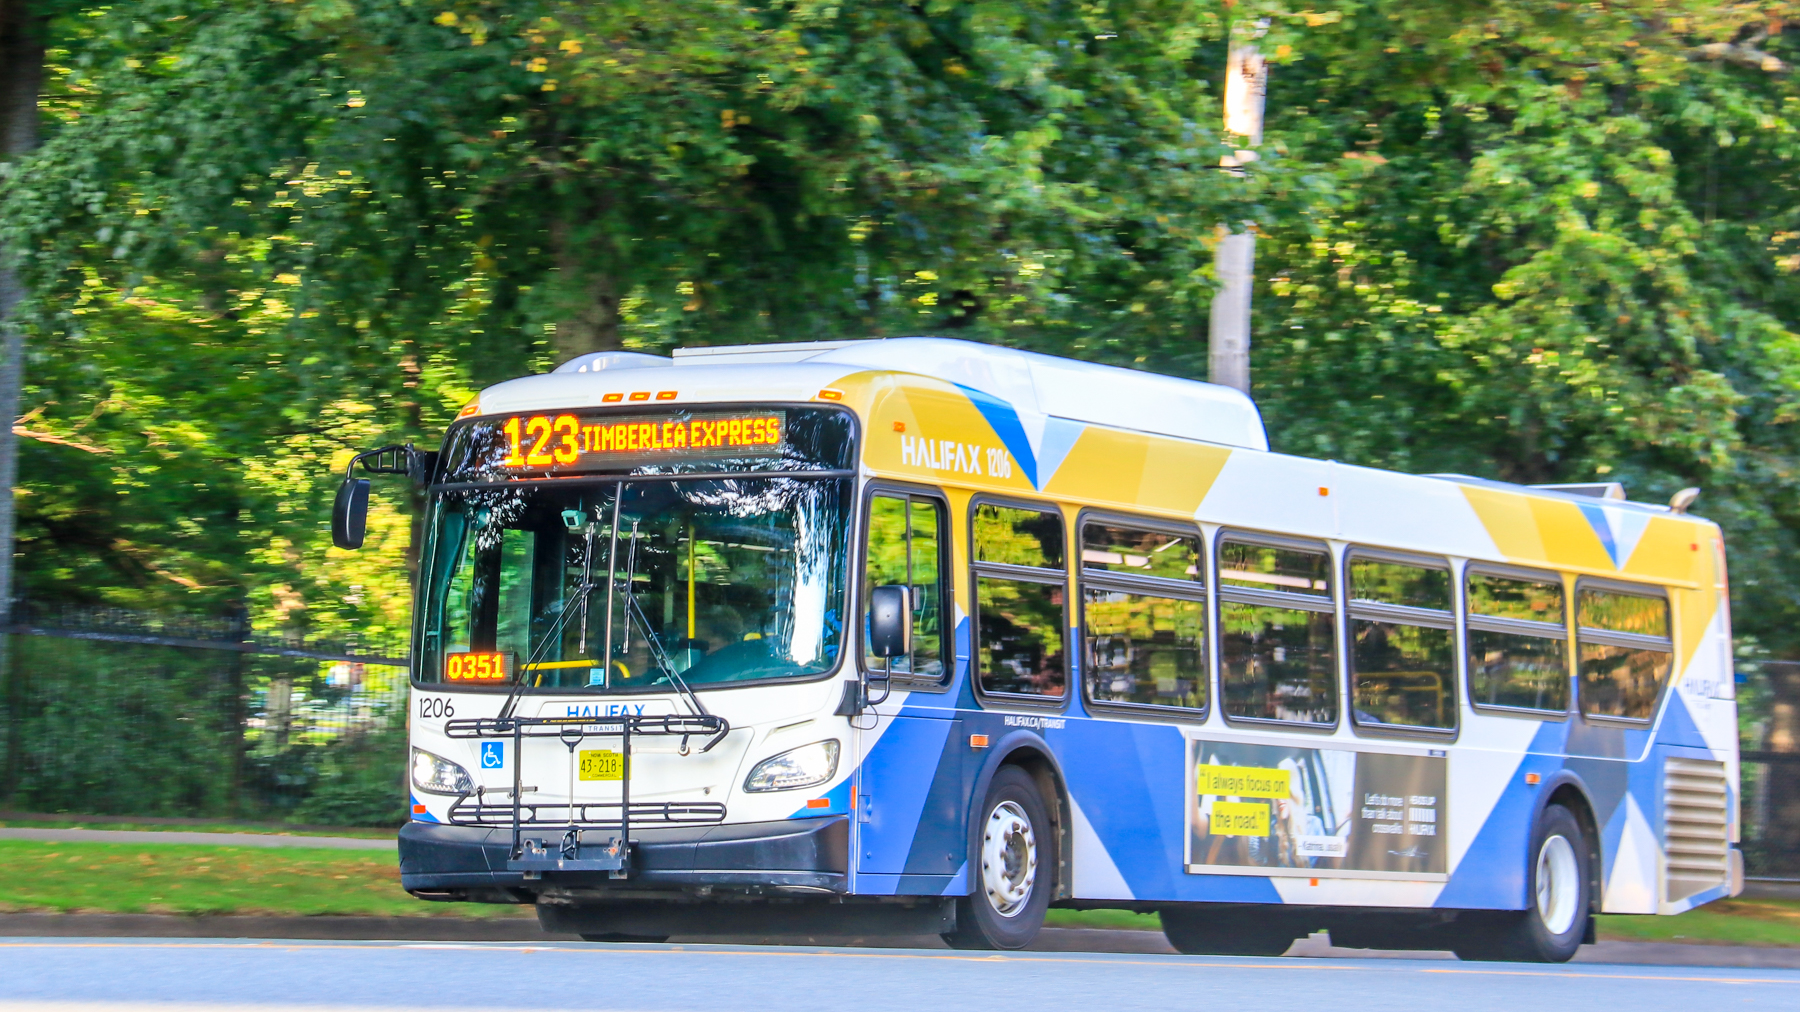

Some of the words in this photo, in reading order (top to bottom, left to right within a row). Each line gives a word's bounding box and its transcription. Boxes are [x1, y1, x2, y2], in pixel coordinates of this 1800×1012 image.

[503, 415, 580, 467] 123
[582, 423, 687, 451] TIMBERLEA
[690, 418, 780, 447] EXPRESS
[901, 434, 982, 475] HALIFAX
[986, 447, 1011, 479] 1206
[448, 654, 504, 680] 0351
[419, 697, 455, 719] 1206
[588, 725, 624, 733] TRANSIT
[1212, 772, 1244, 794] always
[1246, 775, 1271, 792] focus
[1273, 780, 1286, 793] on
[1215, 809, 1232, 828] the
